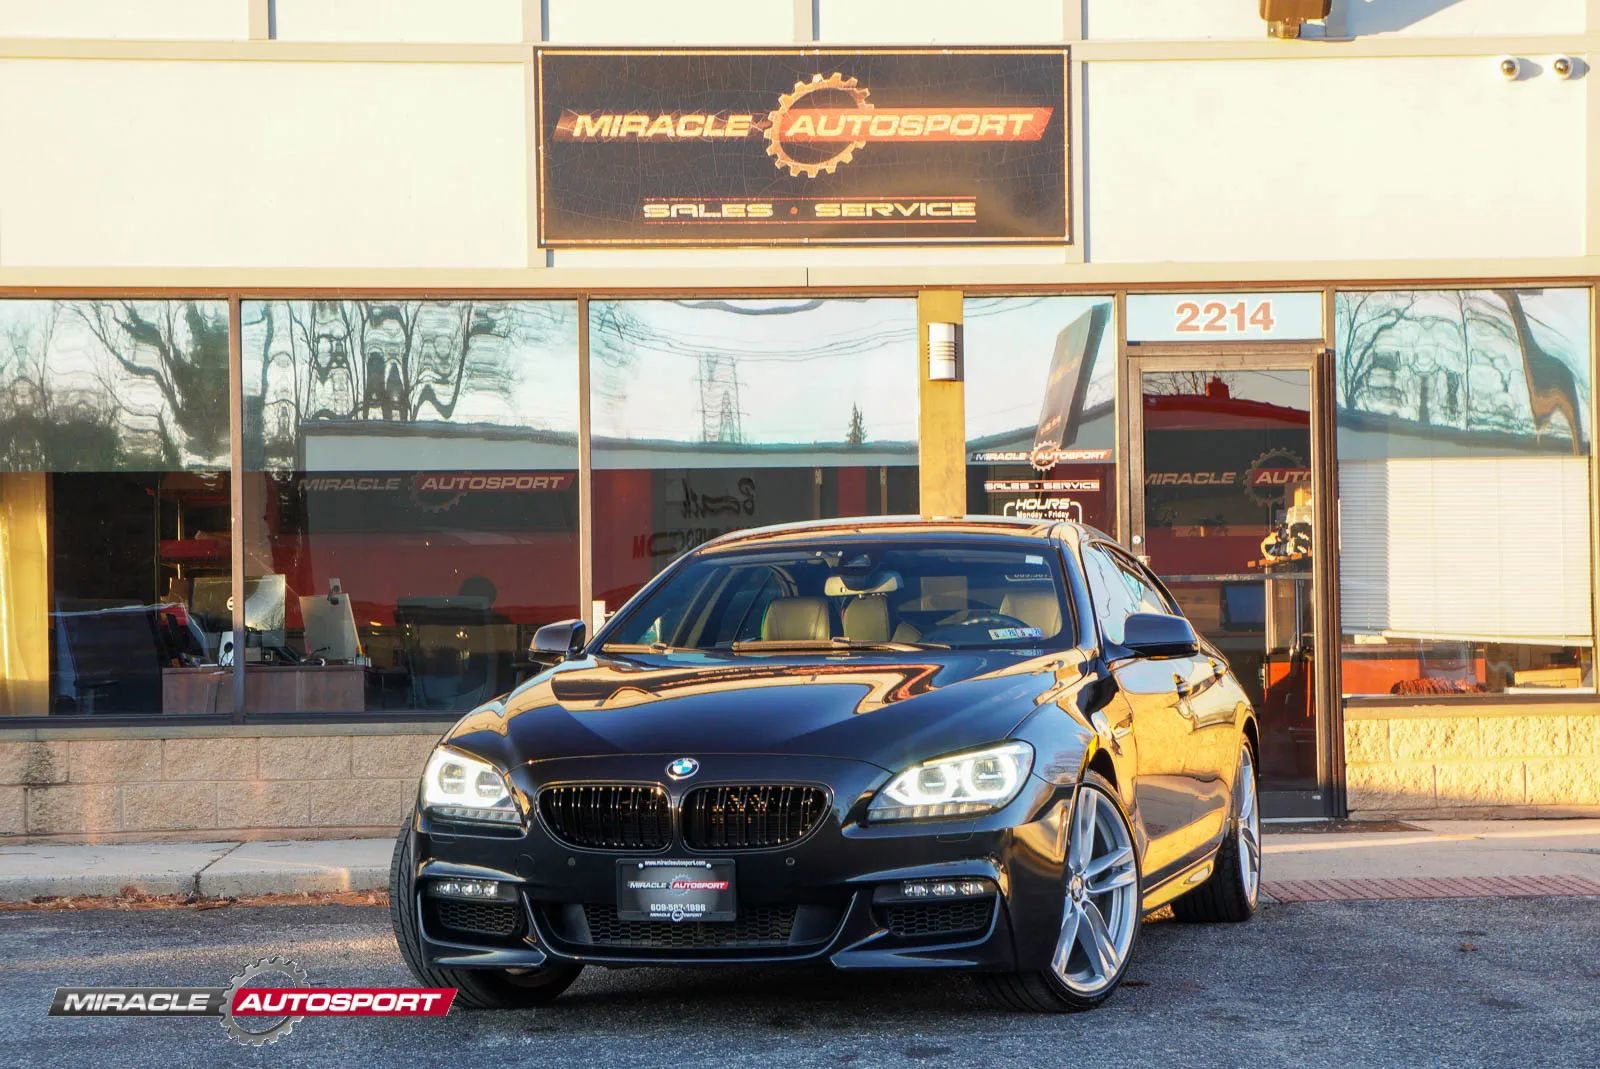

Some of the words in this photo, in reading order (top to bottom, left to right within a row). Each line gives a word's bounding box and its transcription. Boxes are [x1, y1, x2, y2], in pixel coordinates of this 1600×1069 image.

[572, 114, 754, 138] MIRACLE
[784, 113, 1034, 137] AUTOSPORT
[642, 203, 774, 218] SALES
[814, 202, 977, 217] SERVICE
[1174, 299, 1275, 333] 2214
[975, 451, 1027, 461] MIRACLE
[1036, 450, 1108, 461] AUTOSPORT
[297, 477, 402, 491] MIRACLE
[420, 476, 566, 490] AUTOSPORT
[984, 482, 1030, 490] SALES
[1043, 481, 1100, 490] SERVICE
[1015, 498, 1071, 510] HOURS
[1016, 511, 1043, 519] Monday
[1048, 511, 1070, 519] Friday
[673, 881, 726, 889] AUTOSPORT
